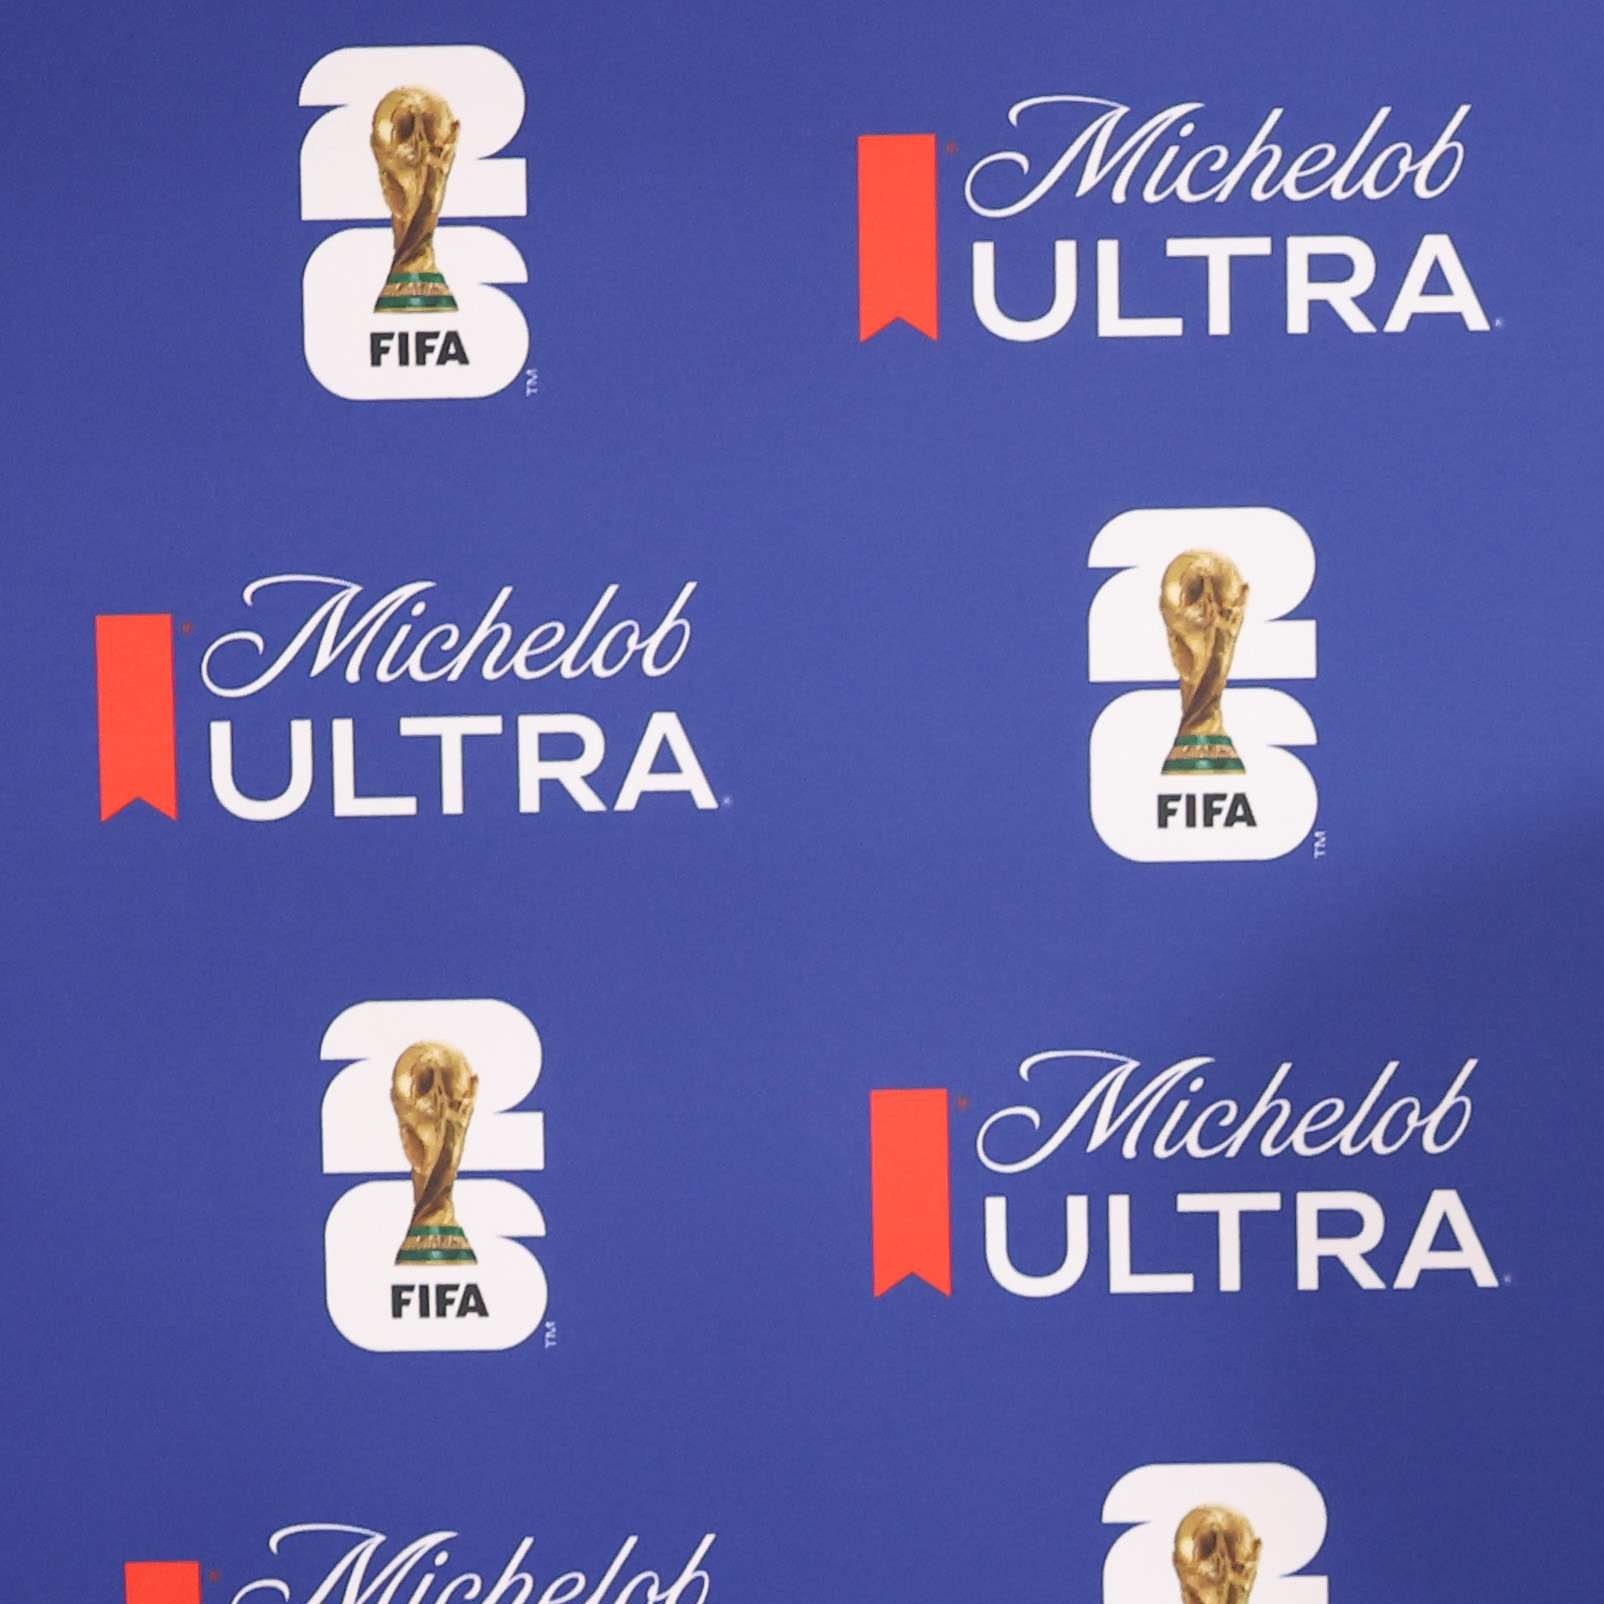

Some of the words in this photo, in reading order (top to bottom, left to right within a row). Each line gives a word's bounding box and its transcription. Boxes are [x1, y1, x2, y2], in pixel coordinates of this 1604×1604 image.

[965, 96, 1471, 217] Michelob
[973, 234, 1490, 341] ULTRA
[370, 331, 469, 367] FIFA
[202, 575, 697, 697] Michelob
[210, 712, 718, 820] ULTRA
[1158, 793, 1257, 828] FIFA
[977, 1050, 1478, 1173] Michelob
[985, 1190, 1498, 1297] ULTRA
[391, 1284, 489, 1318] FIFA
